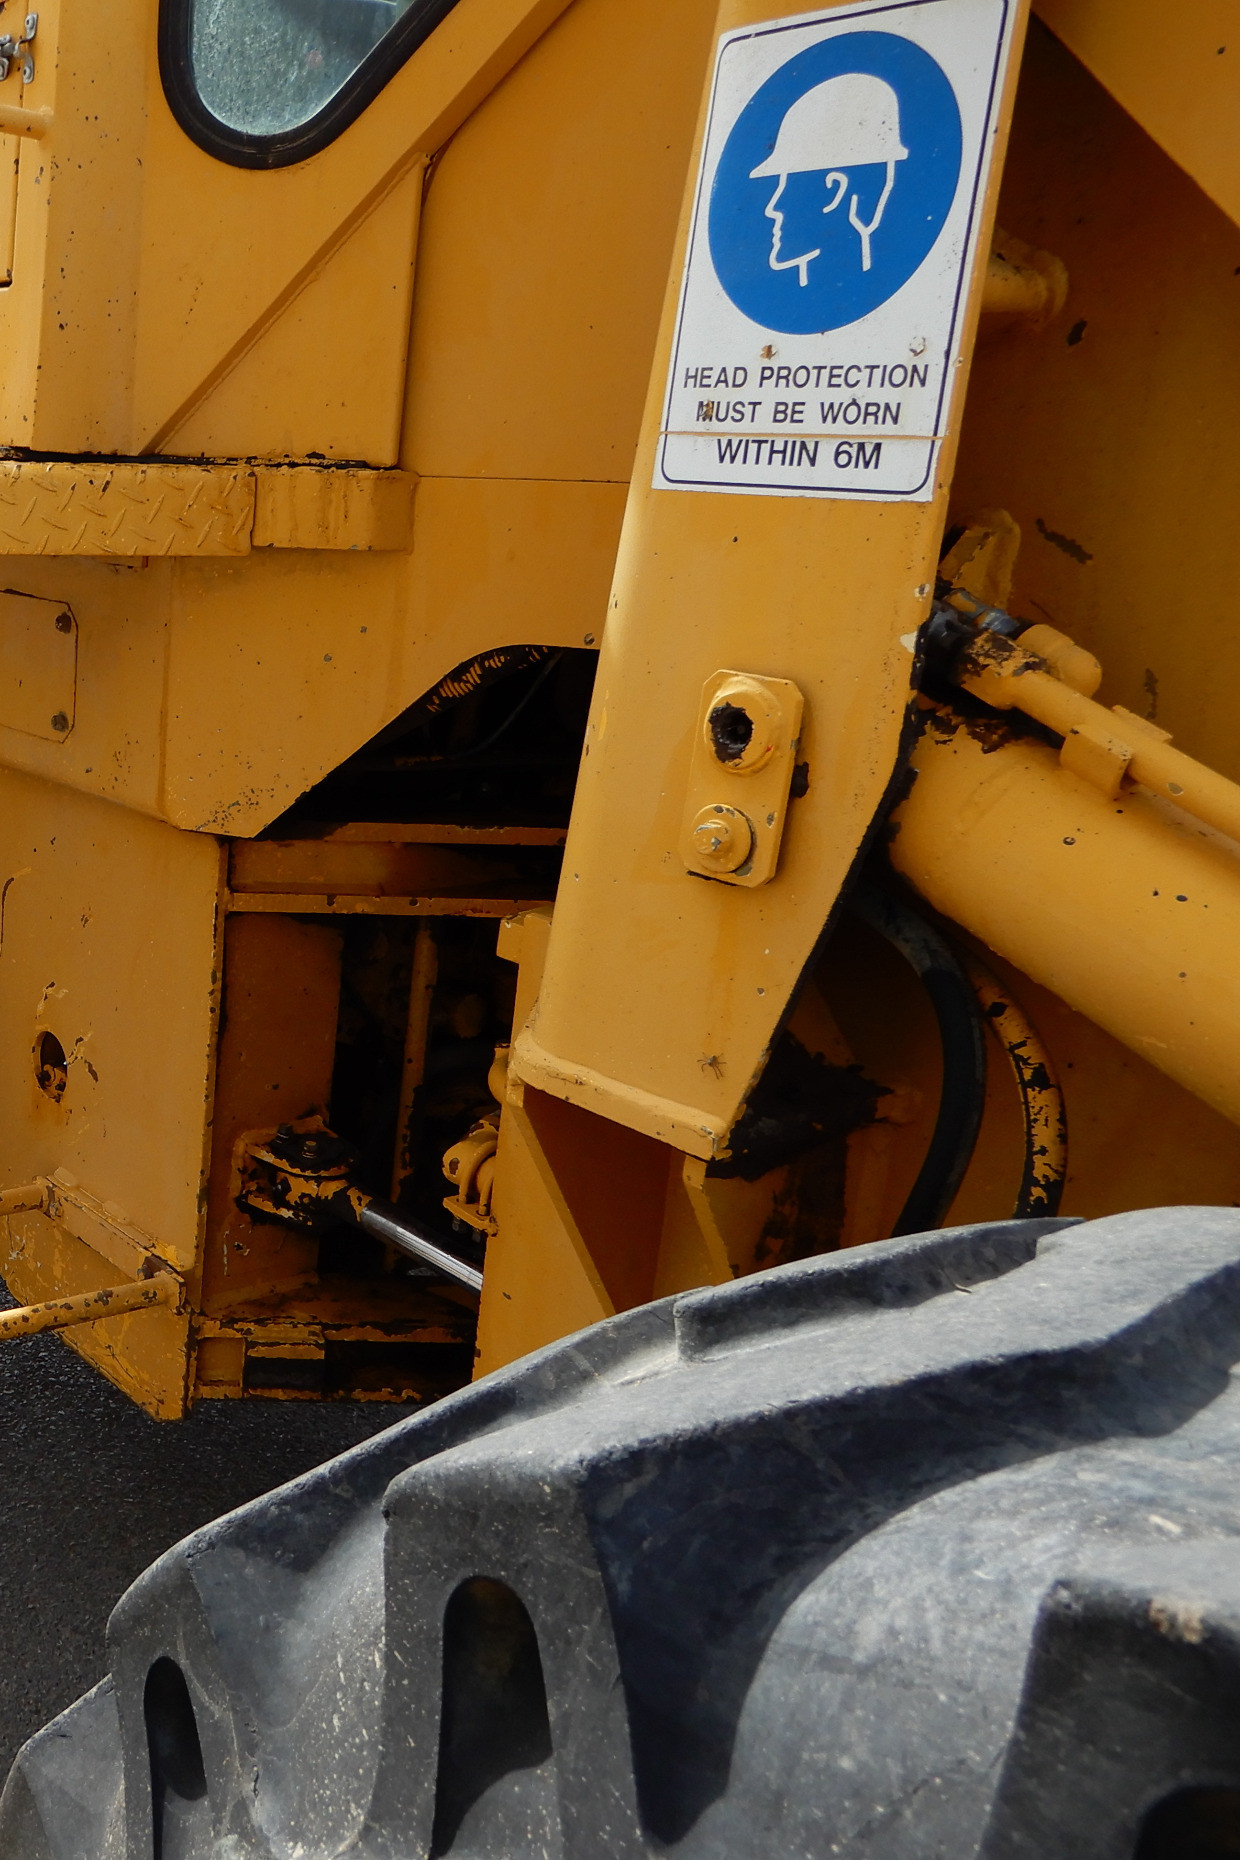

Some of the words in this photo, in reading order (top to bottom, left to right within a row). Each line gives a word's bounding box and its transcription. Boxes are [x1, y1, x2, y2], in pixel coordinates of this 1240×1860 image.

[683, 366, 748, 389] HEAD
[759, 364, 929, 389] PROTECTION
[696, 400, 762, 423] MUST
[772, 402, 806, 424] BE
[819, 402, 902, 425] WORN
[717, 438, 819, 468] WITHIN
[833, 440, 883, 470] 6M
